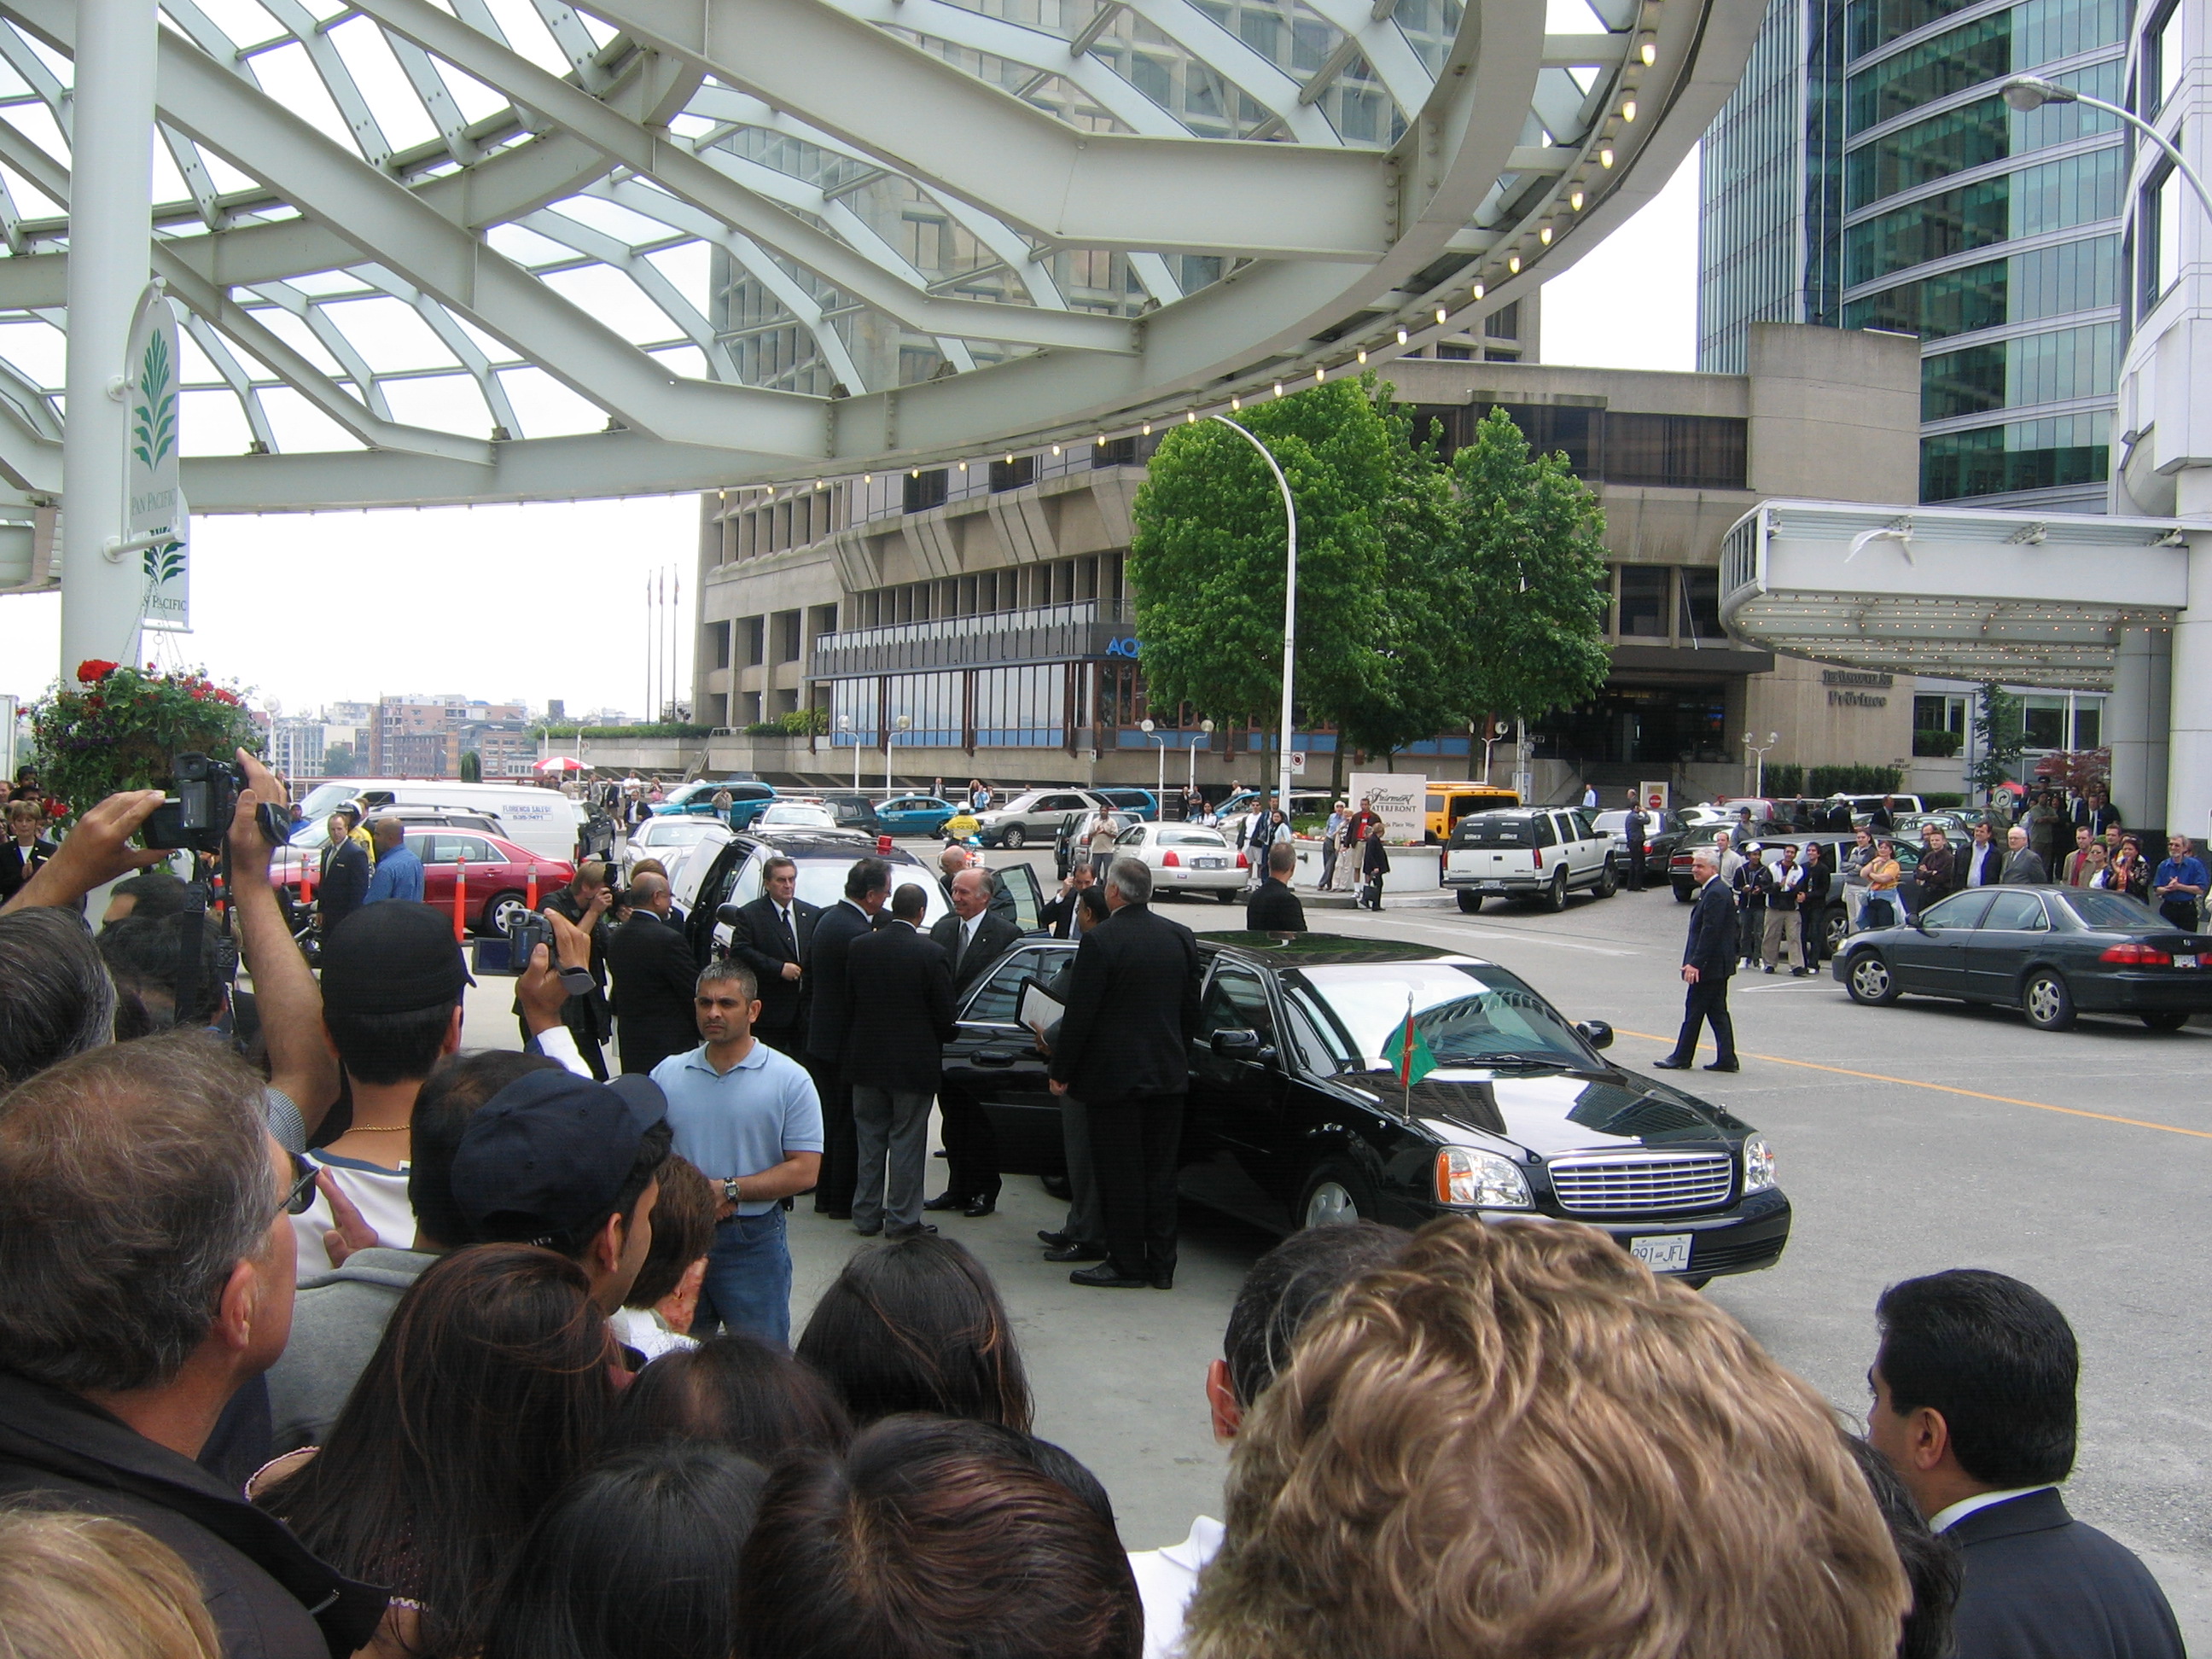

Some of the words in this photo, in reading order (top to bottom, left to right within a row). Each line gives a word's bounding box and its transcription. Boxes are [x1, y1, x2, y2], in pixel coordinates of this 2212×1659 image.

[131, 497, 145, 515] PAN
[148, 487, 177, 511] PACIFIC
[152, 595, 187, 611] PACIFIC
[1365, 787, 1415, 805] Fairmont
[1662, 1244, 1687, 1262] JFL
